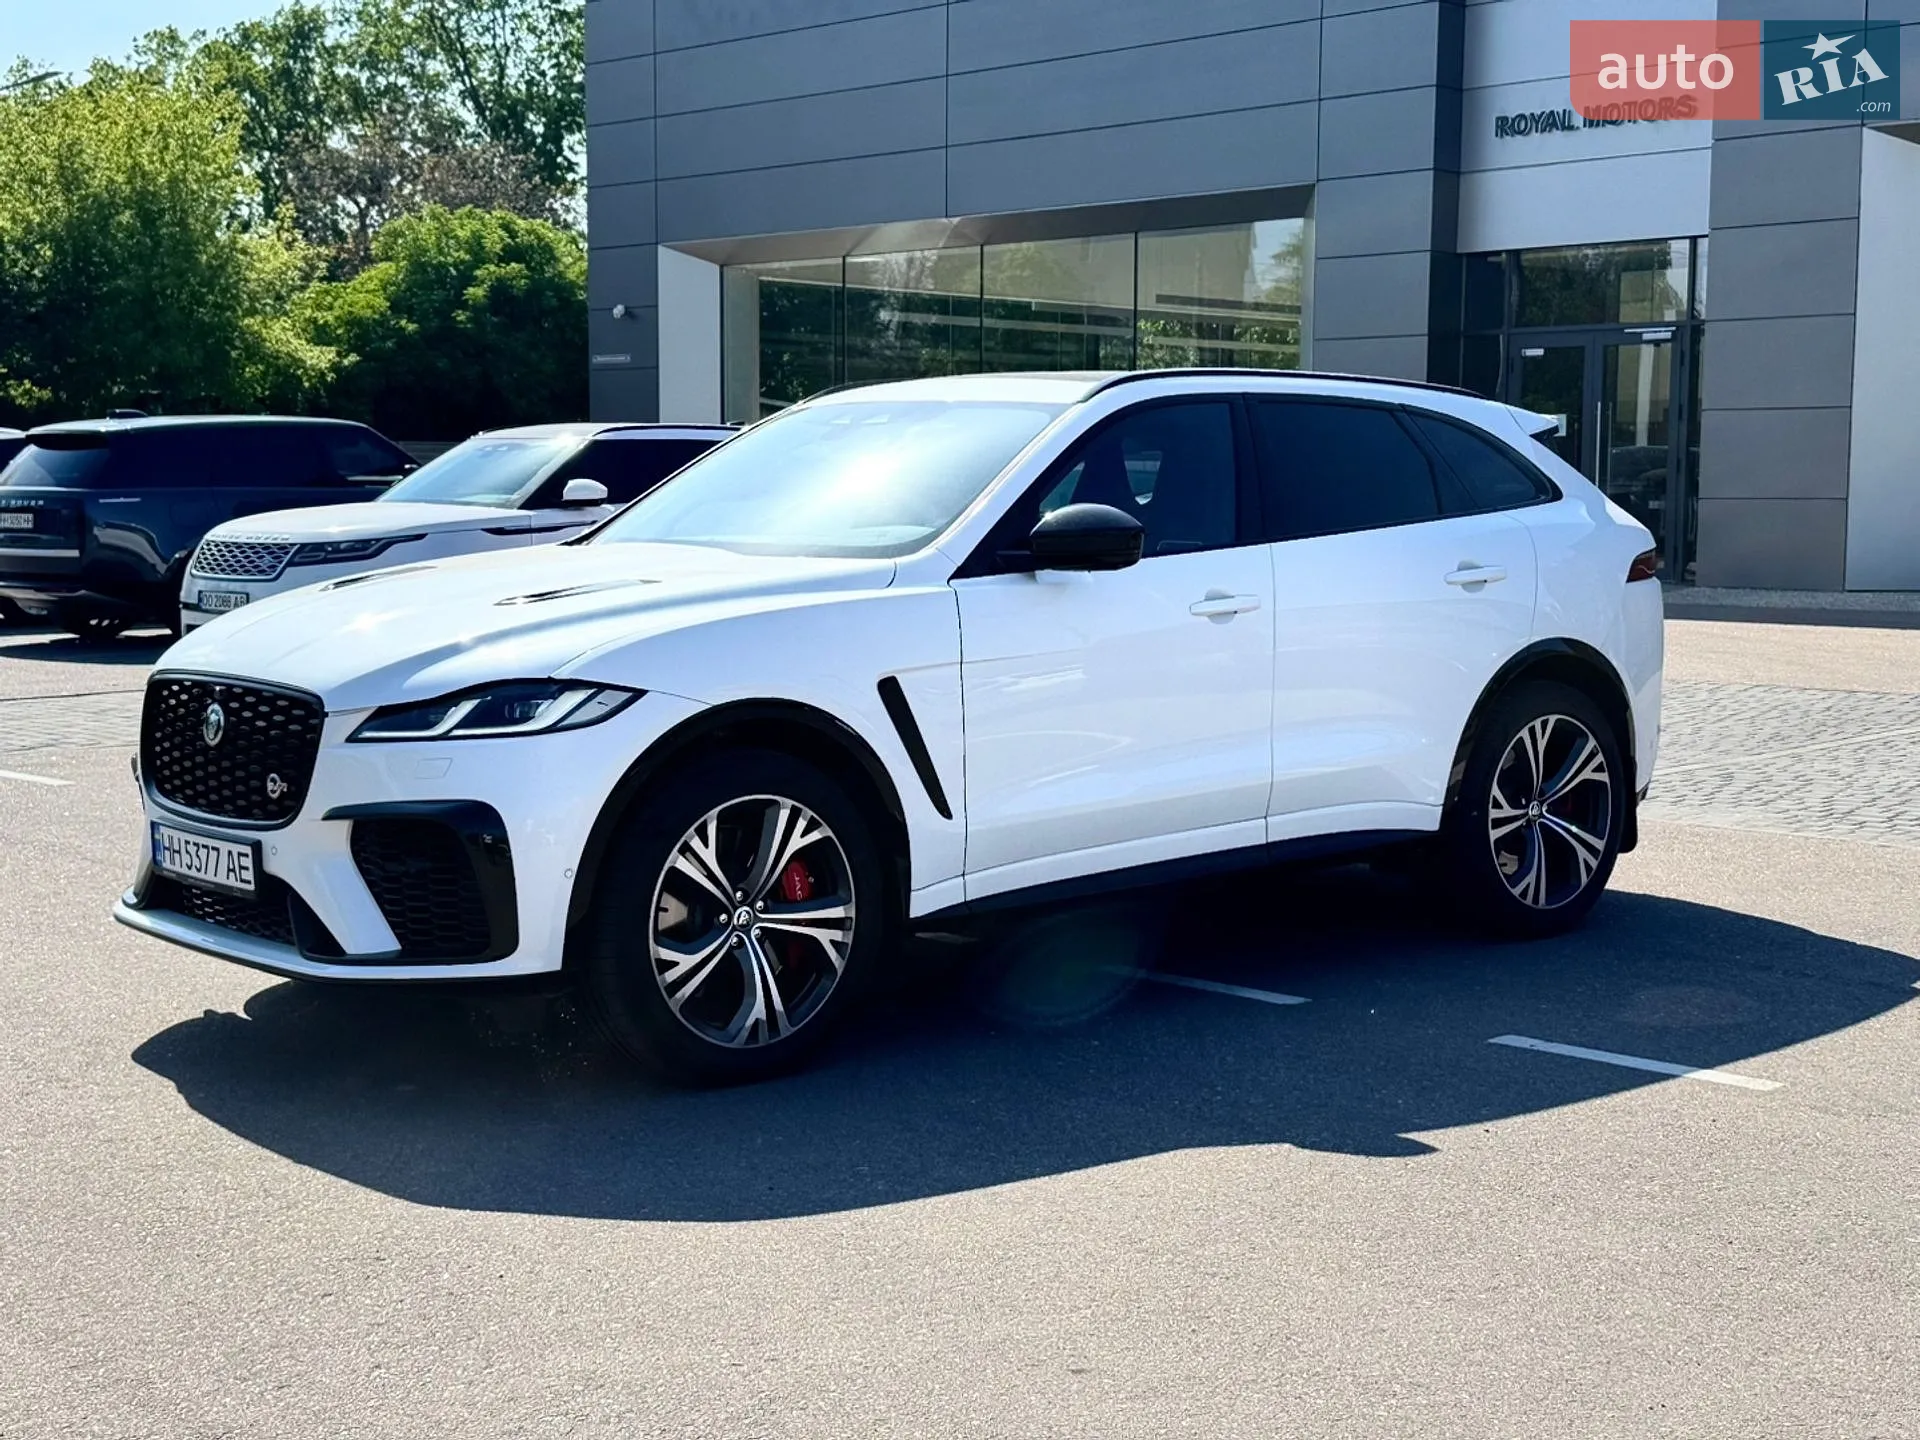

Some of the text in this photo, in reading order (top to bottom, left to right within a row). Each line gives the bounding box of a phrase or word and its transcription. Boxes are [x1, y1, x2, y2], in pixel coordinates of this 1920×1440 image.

[1494, 94, 1699, 138] ROYAL MOTORS
[161, 832, 253, 886] HH 5377 AE
